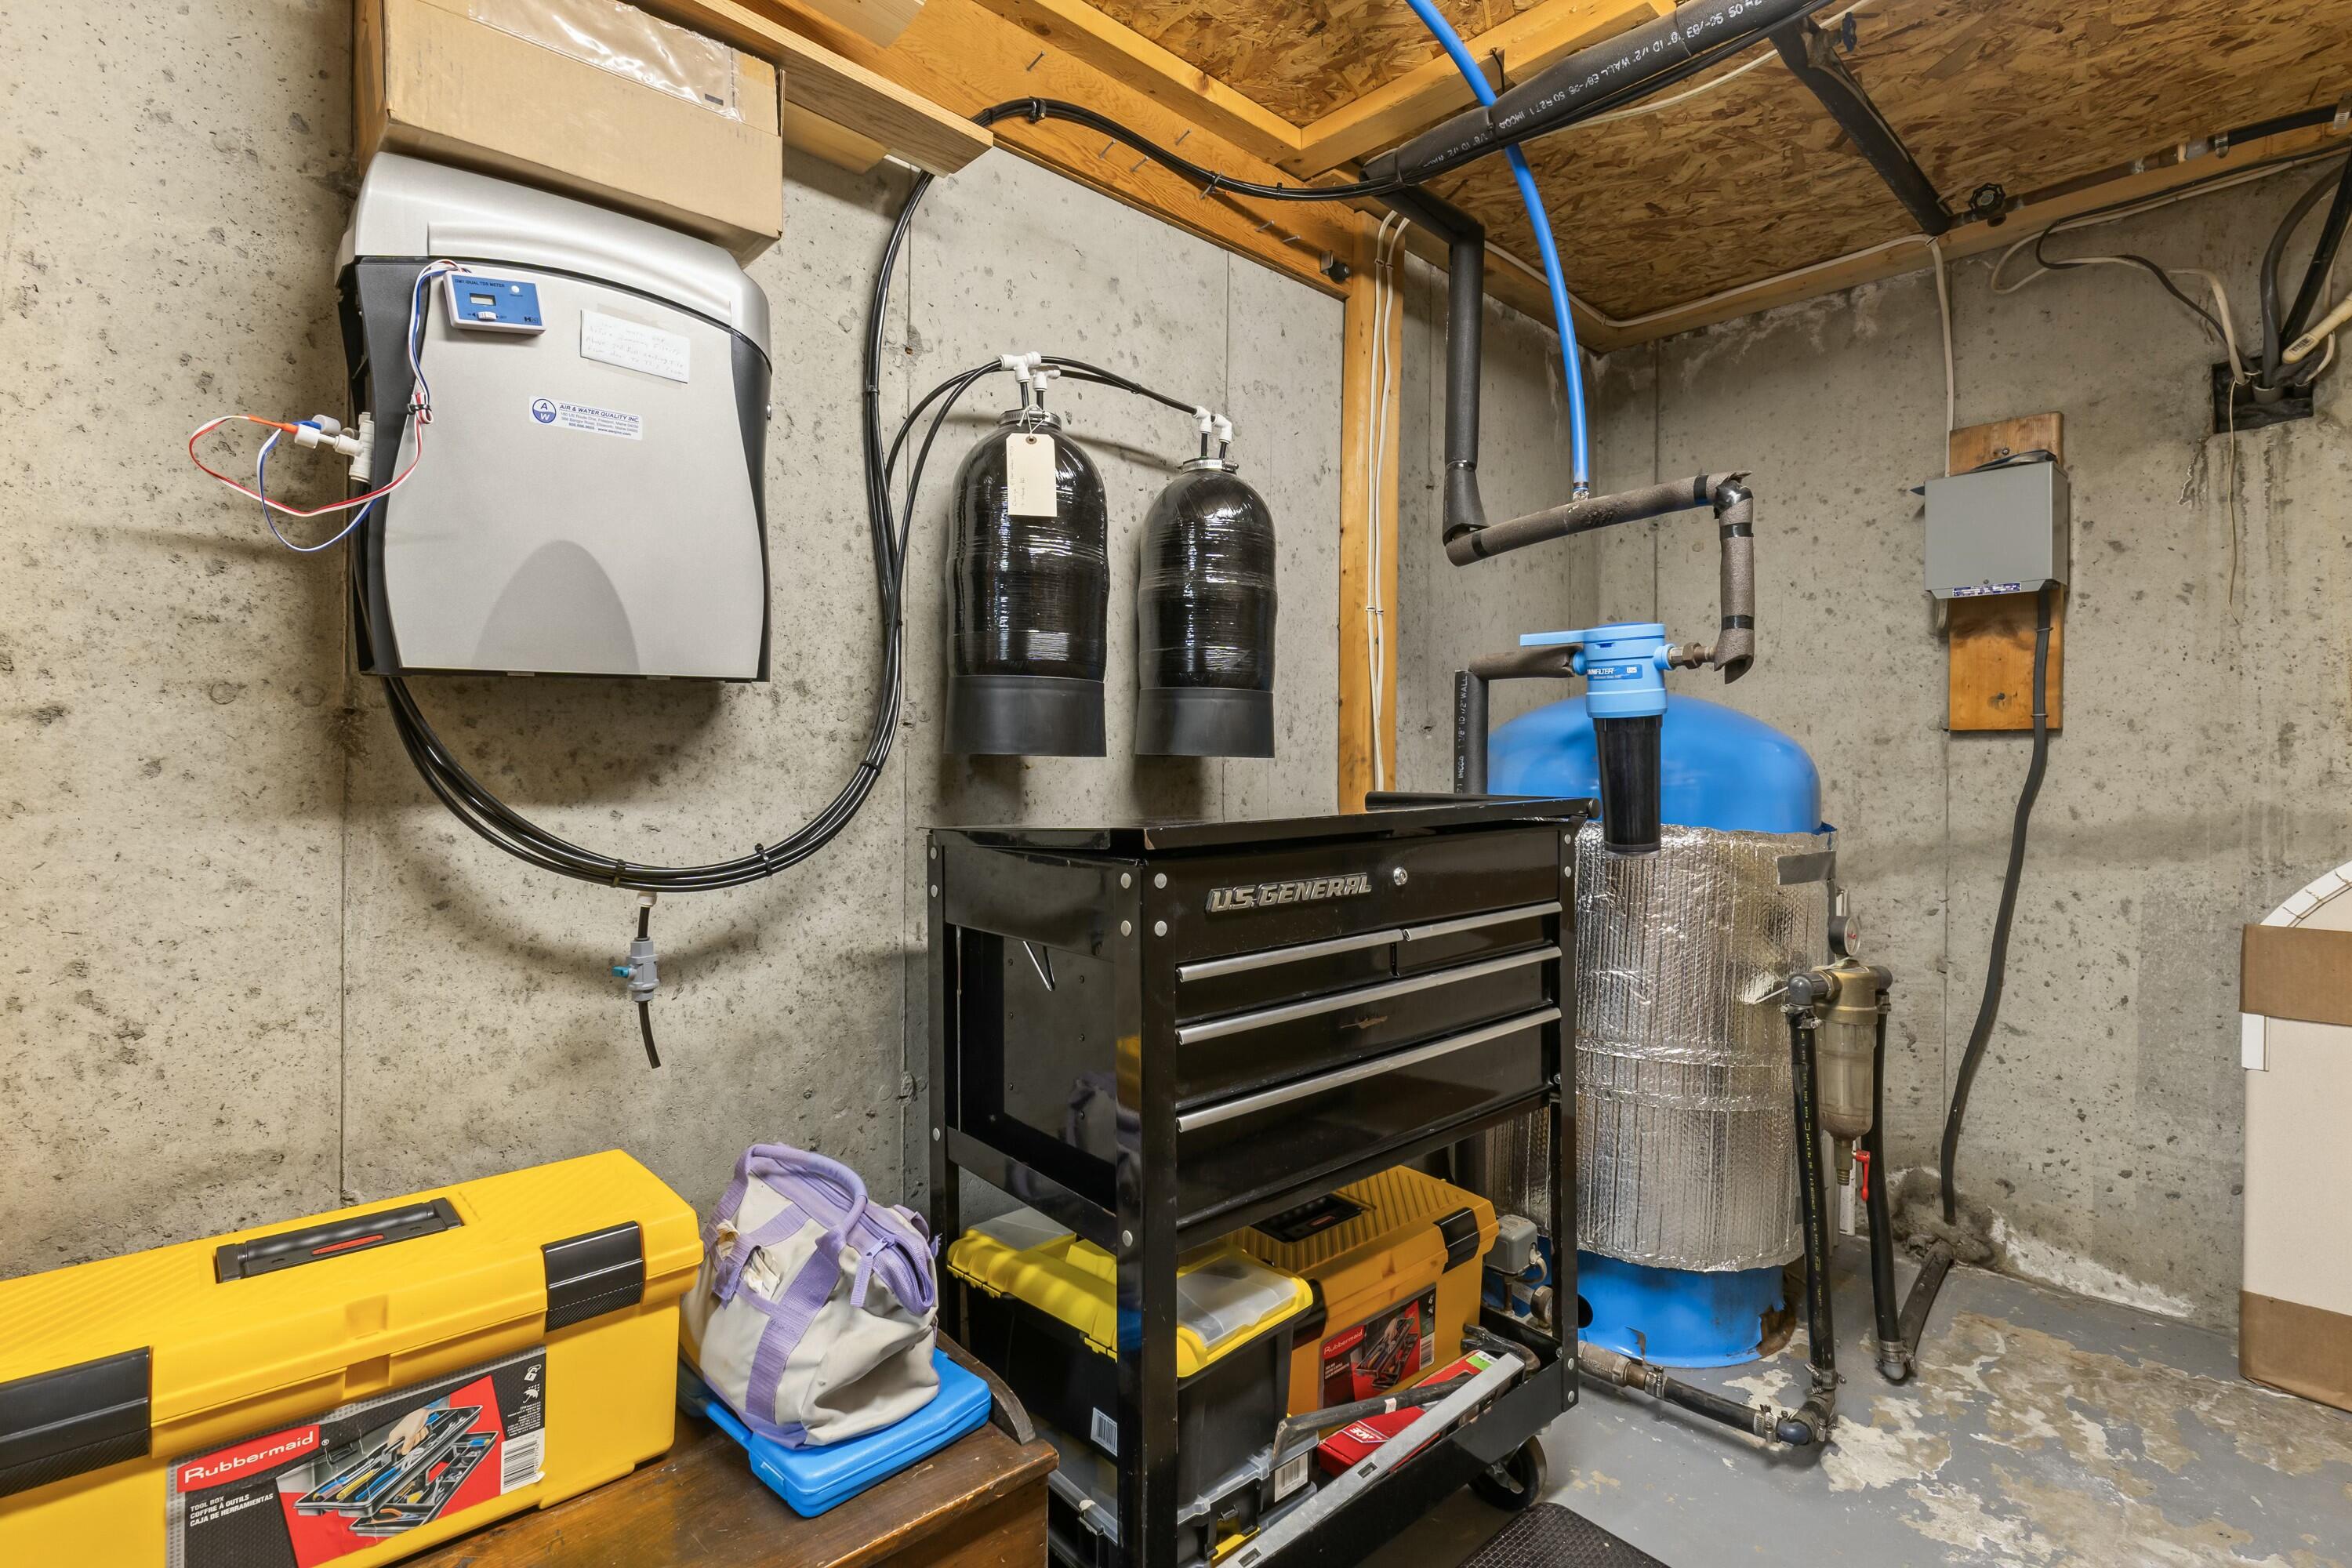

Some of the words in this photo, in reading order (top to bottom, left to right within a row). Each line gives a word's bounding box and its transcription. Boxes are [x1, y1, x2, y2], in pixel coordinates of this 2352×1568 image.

[578, 407, 599, 416] WATER
[601, 412, 628, 420] QUALITY
[1258, 875, 1372, 906] GENERAL
[1324, 1328, 1363, 1355] Rubbermaid
[184, 1430, 314, 1484] Rubbermaid
[190, 1506, 217, 1519] COFFRE
[225, 1494, 249, 1508] OUTILS
[190, 1516, 209, 1527] CAJA
[210, 1512, 219, 1520] DE
[220, 1493, 274, 1517] HERRAMIENTAS
[191, 1501, 209, 1512] TOOL
[209, 1496, 224, 1505] BOX
